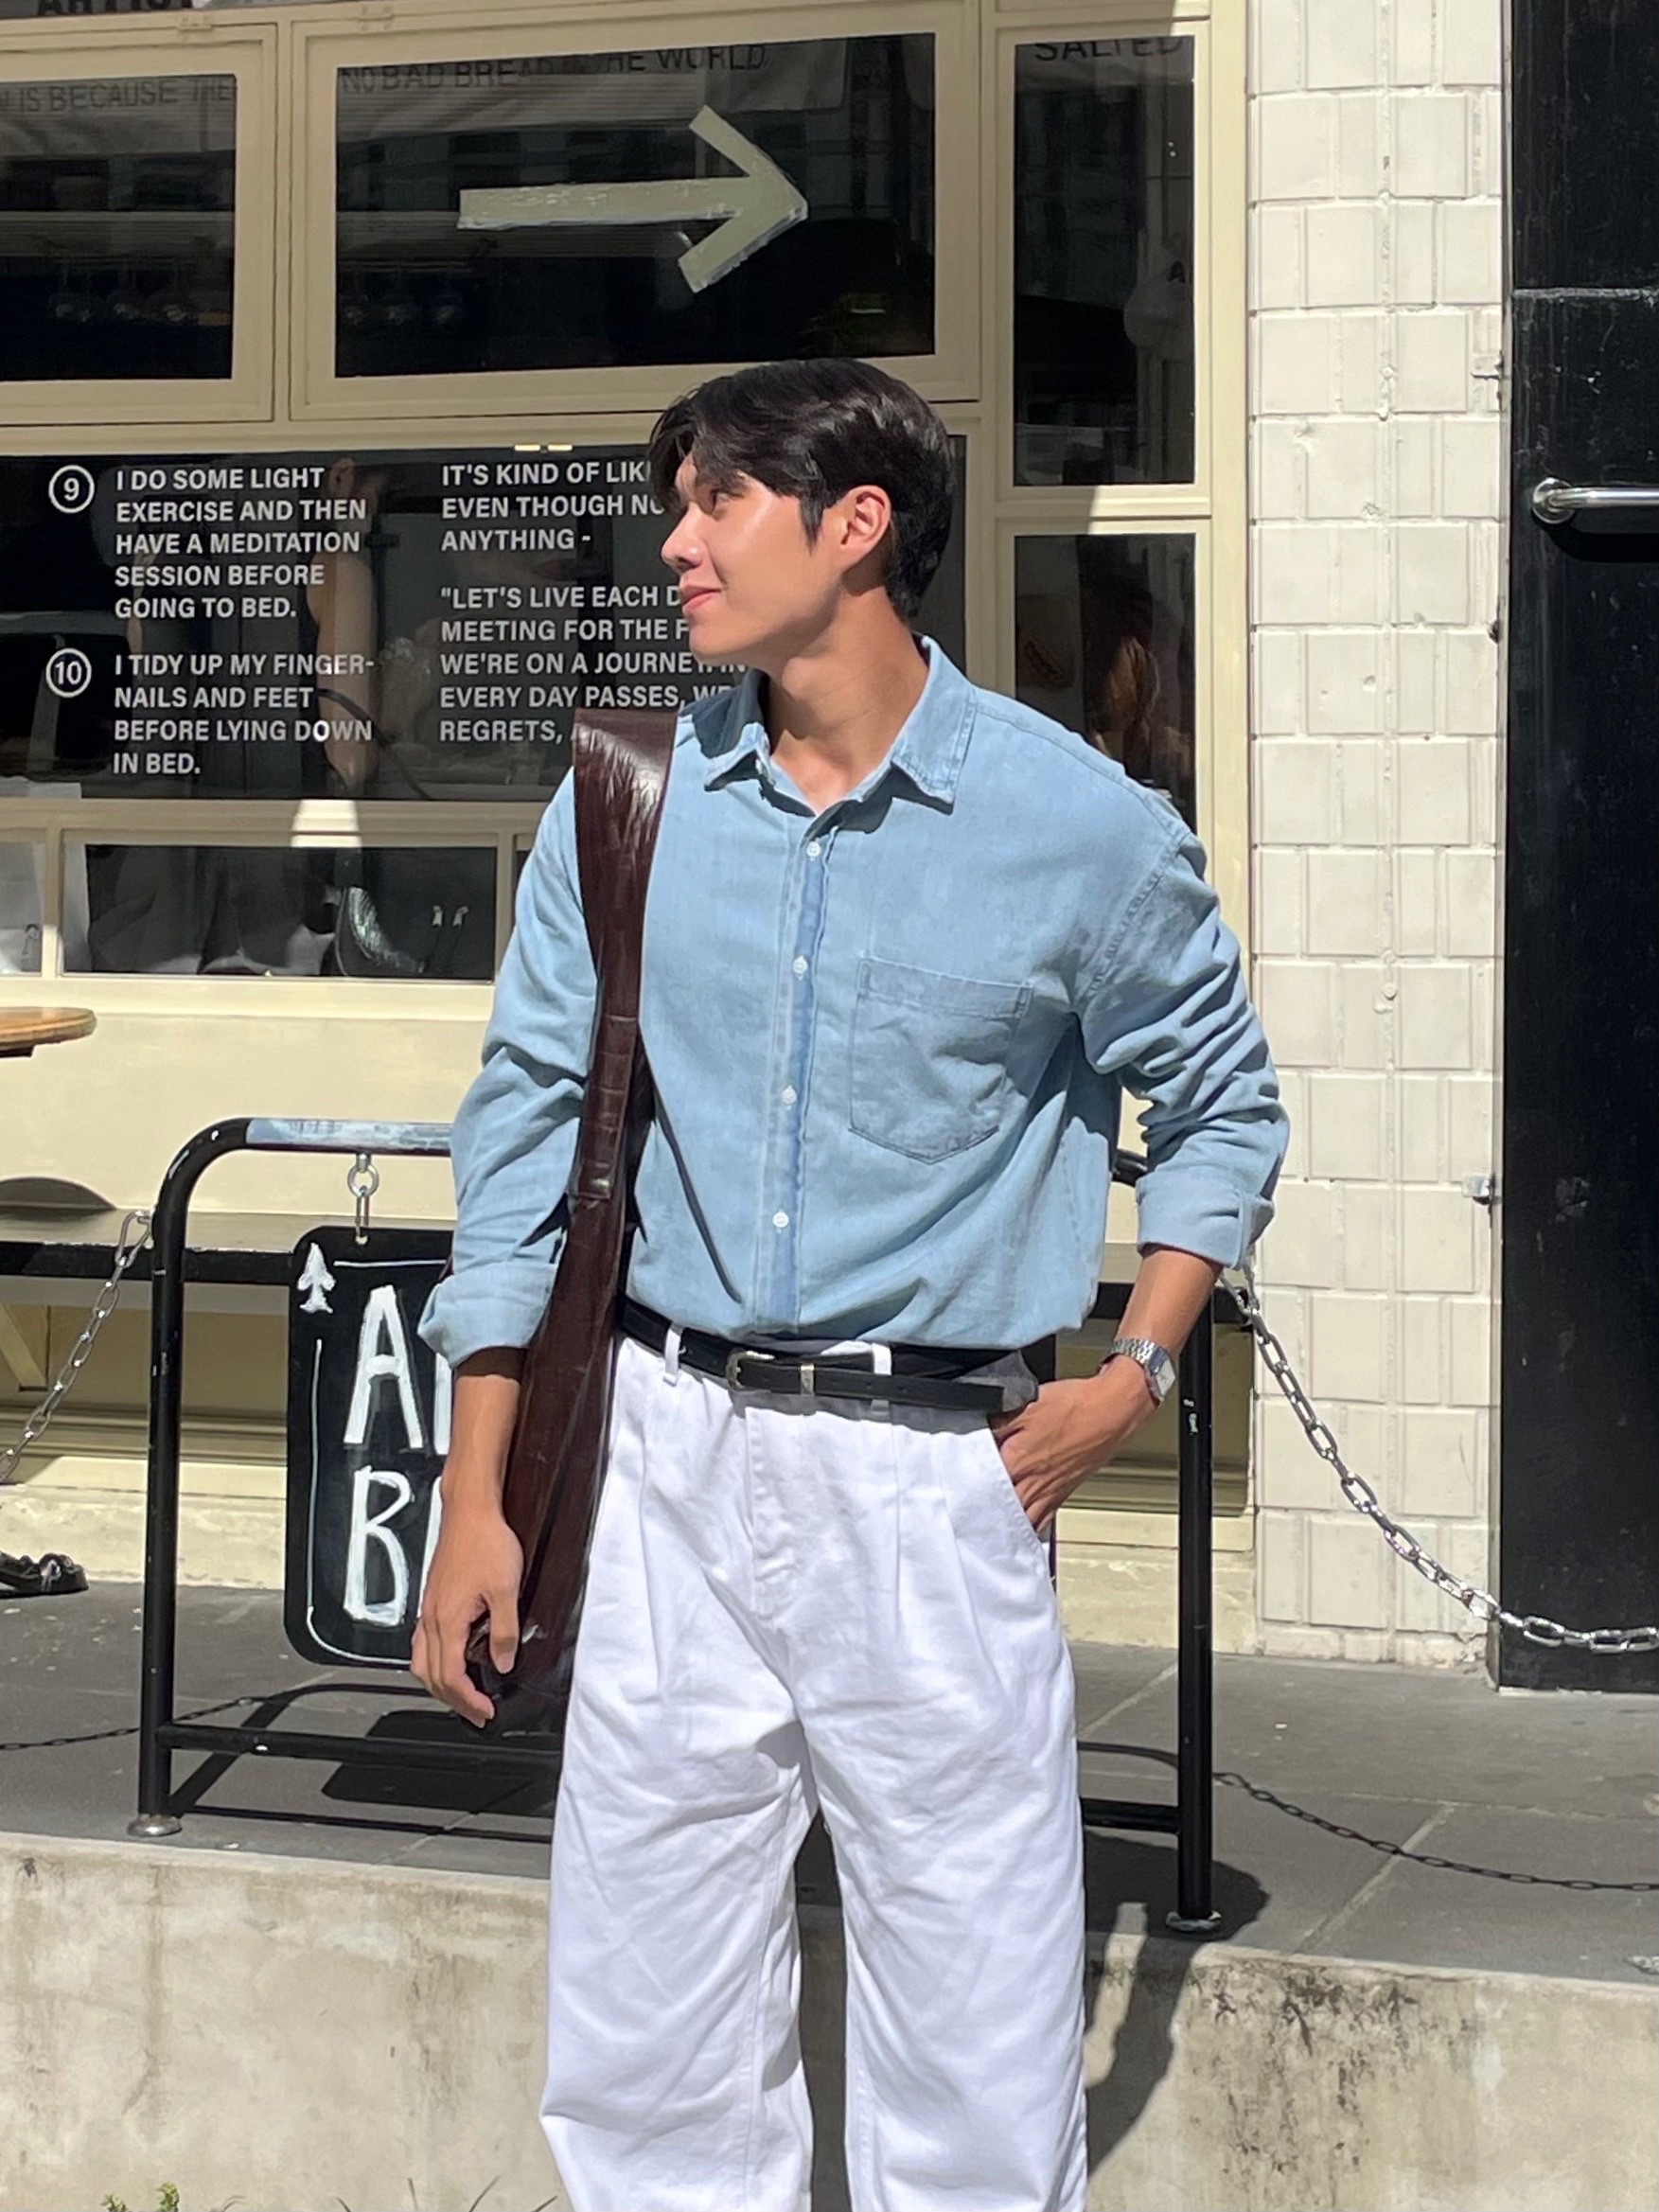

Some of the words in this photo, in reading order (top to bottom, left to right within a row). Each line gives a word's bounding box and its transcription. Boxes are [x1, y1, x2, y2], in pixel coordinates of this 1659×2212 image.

[1034, 37, 1183, 62] SALTED
[381, 63, 445, 90] BAD
[657, 44, 766, 70] WORLD
[20, 88, 41, 113] IS
[49, 80, 179, 112] BECAUSE
[117, 471, 122, 490] I
[132, 470, 166, 489] DO
[173, 469, 243, 489] SOME
[252, 468, 325, 487] LIGHT
[444, 465, 488, 486] IT'S
[497, 464, 558, 485] KIND
[567, 462, 599, 483] OF
[607, 461, 651, 484] LIK
[117, 502, 233, 522] EXERCISE
[240, 501, 292, 521] AND
[300, 500, 365, 520] THEN
[443, 497, 507, 518] EVEN
[517, 495, 623, 516] THOUGH
[116, 534, 179, 554] HAVE
[186, 534, 203, 553] A
[211, 532, 359, 553] MEDITATION
[442, 529, 574, 551] ANYTHING
[115, 566, 220, 586] SESSION
[229, 565, 324, 585] BEFORE
[115, 598, 194, 618] GOING
[202, 598, 234, 617] TO
[242, 598, 295, 617] BED.
[442, 587, 521, 608] "LET'S
[531, 587, 584, 607] LIVE
[593, 586, 658, 607] EACH
[442, 621, 555, 641] MEETING
[565, 620, 612, 640] FOR
[620, 619, 667, 639] THE
[55, 661, 80, 685] 10
[116, 655, 121, 674] I
[129, 655, 183, 675] TIDY
[191, 655, 222, 674] UP
[231, 655, 266, 674] MY
[274, 654, 374, 675] FINGER-
[441, 653, 518, 674] WE'RE
[527, 653, 562, 673] ON
[572, 653, 588, 673] A
[115, 687, 186, 707] NAILS
[194, 688, 245, 707] AND
[255, 688, 313, 707] FEET
[441, 687, 521, 707] EVERY
[530, 687, 577, 706] DAY
[585, 686, 685, 711] PASSES,
[693, 686, 733, 702] W
[115, 720, 208, 740] BEFORE
[218, 720, 285, 740] LYING
[295, 720, 371, 741] DOWN
[441, 720, 562, 743] REGRETS,
[115, 753, 137, 773] IN
[147, 753, 200, 773] BED.
